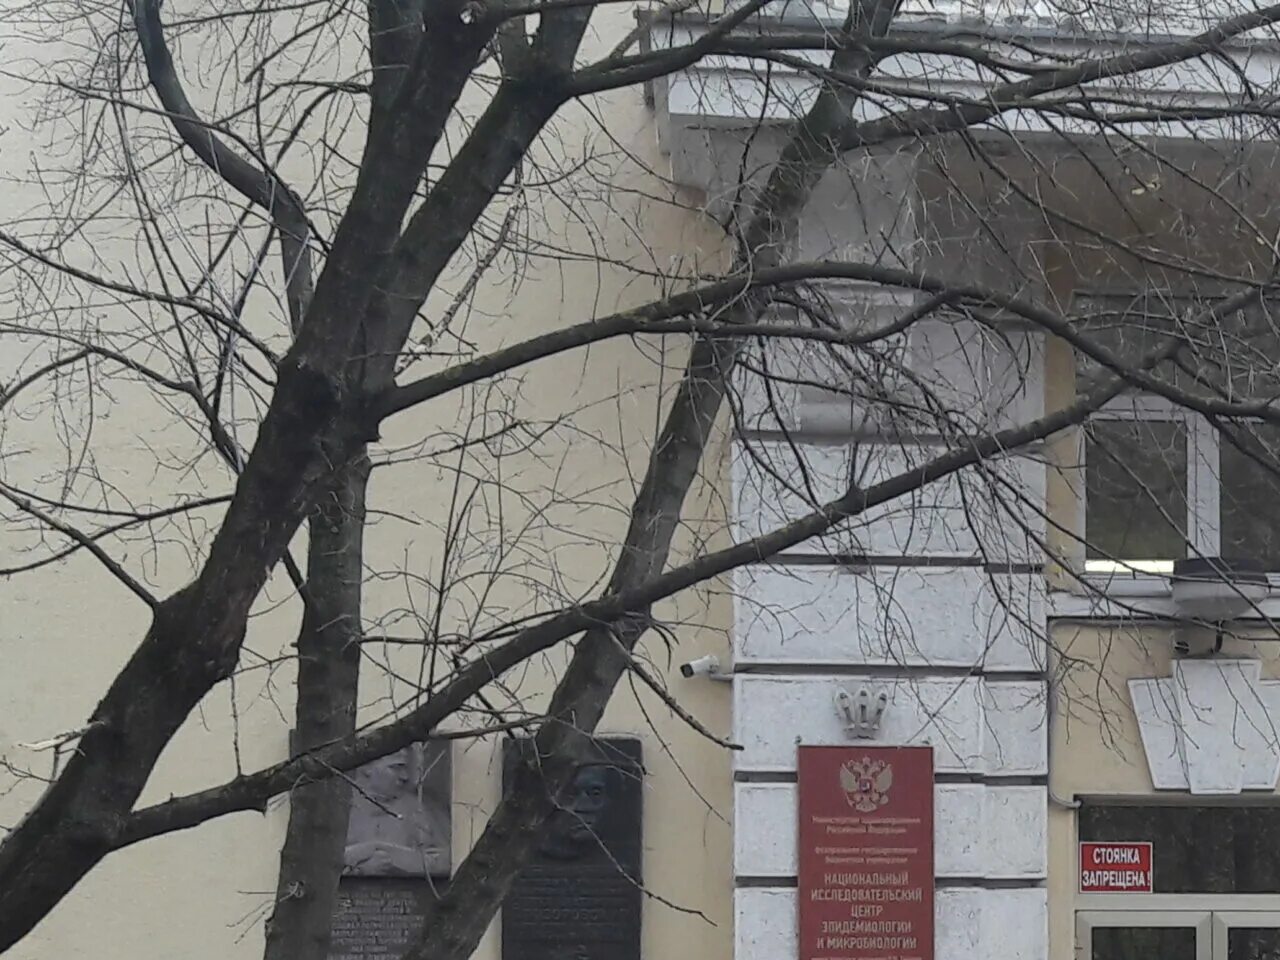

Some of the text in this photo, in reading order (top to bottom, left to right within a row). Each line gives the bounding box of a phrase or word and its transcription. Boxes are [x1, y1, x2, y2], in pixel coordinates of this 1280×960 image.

[1093, 847, 1140, 864] СТОЯНКА
[824, 871, 909, 886] НАЦИОНАЛЬНЫЙ
[811, 888, 922, 902] ИССЛЕДОВАТЕЛЬСКИЙ
[851, 904, 883, 918] ЦЕНТР
[822, 921, 912, 935] ЭПИДЕМИОЛОГИИ
[827, 937, 917, 949] МИКРОБИОЛОГИИ
